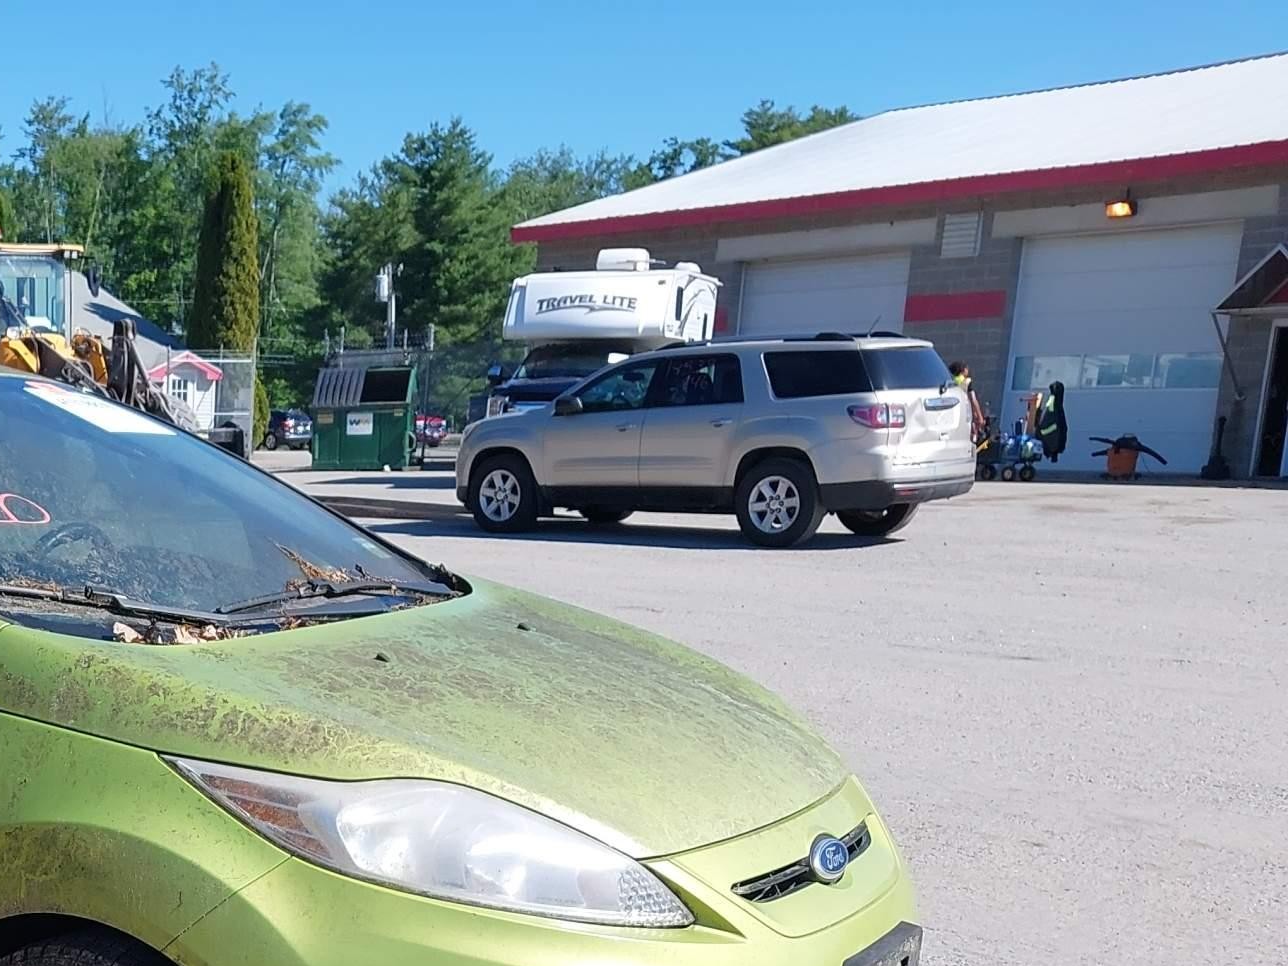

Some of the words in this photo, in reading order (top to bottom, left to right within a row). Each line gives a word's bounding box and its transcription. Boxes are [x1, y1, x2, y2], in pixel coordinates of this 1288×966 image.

[536, 294, 597, 311] TRAVEL
[602, 294, 637, 309] LITE
[824, 846, 846, 869] Ford
